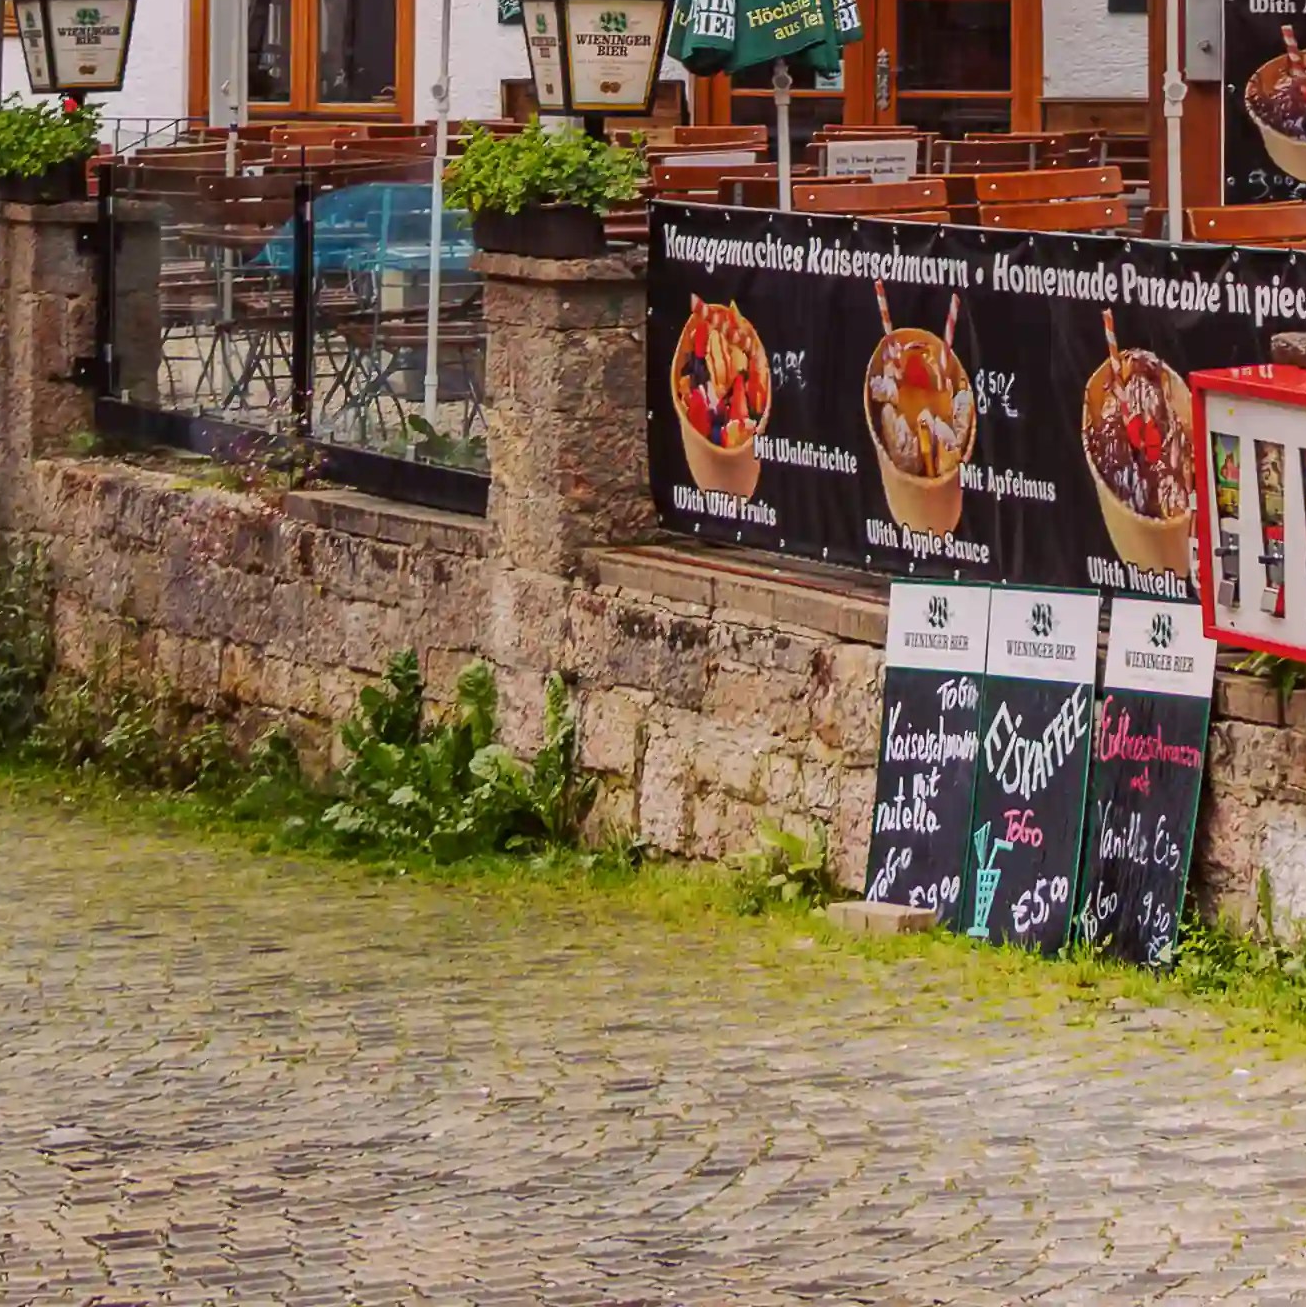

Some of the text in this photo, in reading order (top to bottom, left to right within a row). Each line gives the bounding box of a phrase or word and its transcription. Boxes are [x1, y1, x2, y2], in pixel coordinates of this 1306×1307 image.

[575, 34, 651, 46] WIENINGER
[596, 45, 629, 57] BIER
[773, 22, 801, 41] aus
[663, 223, 805, 274] Hausgemachtes
[806, 237, 970, 289] Kaiserschmarrn
[993, 251, 1119, 303] Homemade
[1122, 262, 1221, 313] Pancake
[1226, 272, 1251, 314] in
[753, 435, 858, 475] Mit Waldfrüchte
[959, 462, 1057, 502] Mit Apfelmus
[673, 485, 777, 527] With Wild Fruits
[866, 518, 990, 564] With Apple Sauce
[1086, 555, 1188, 598] With Nutella
[903, 632, 969, 652] WIENINGER BIER
[1006, 639, 1076, 661] WIENINGER BIER
[1124, 649, 1194, 672] WIENINGER BIER
[1153, 814, 1181, 871] Eis
